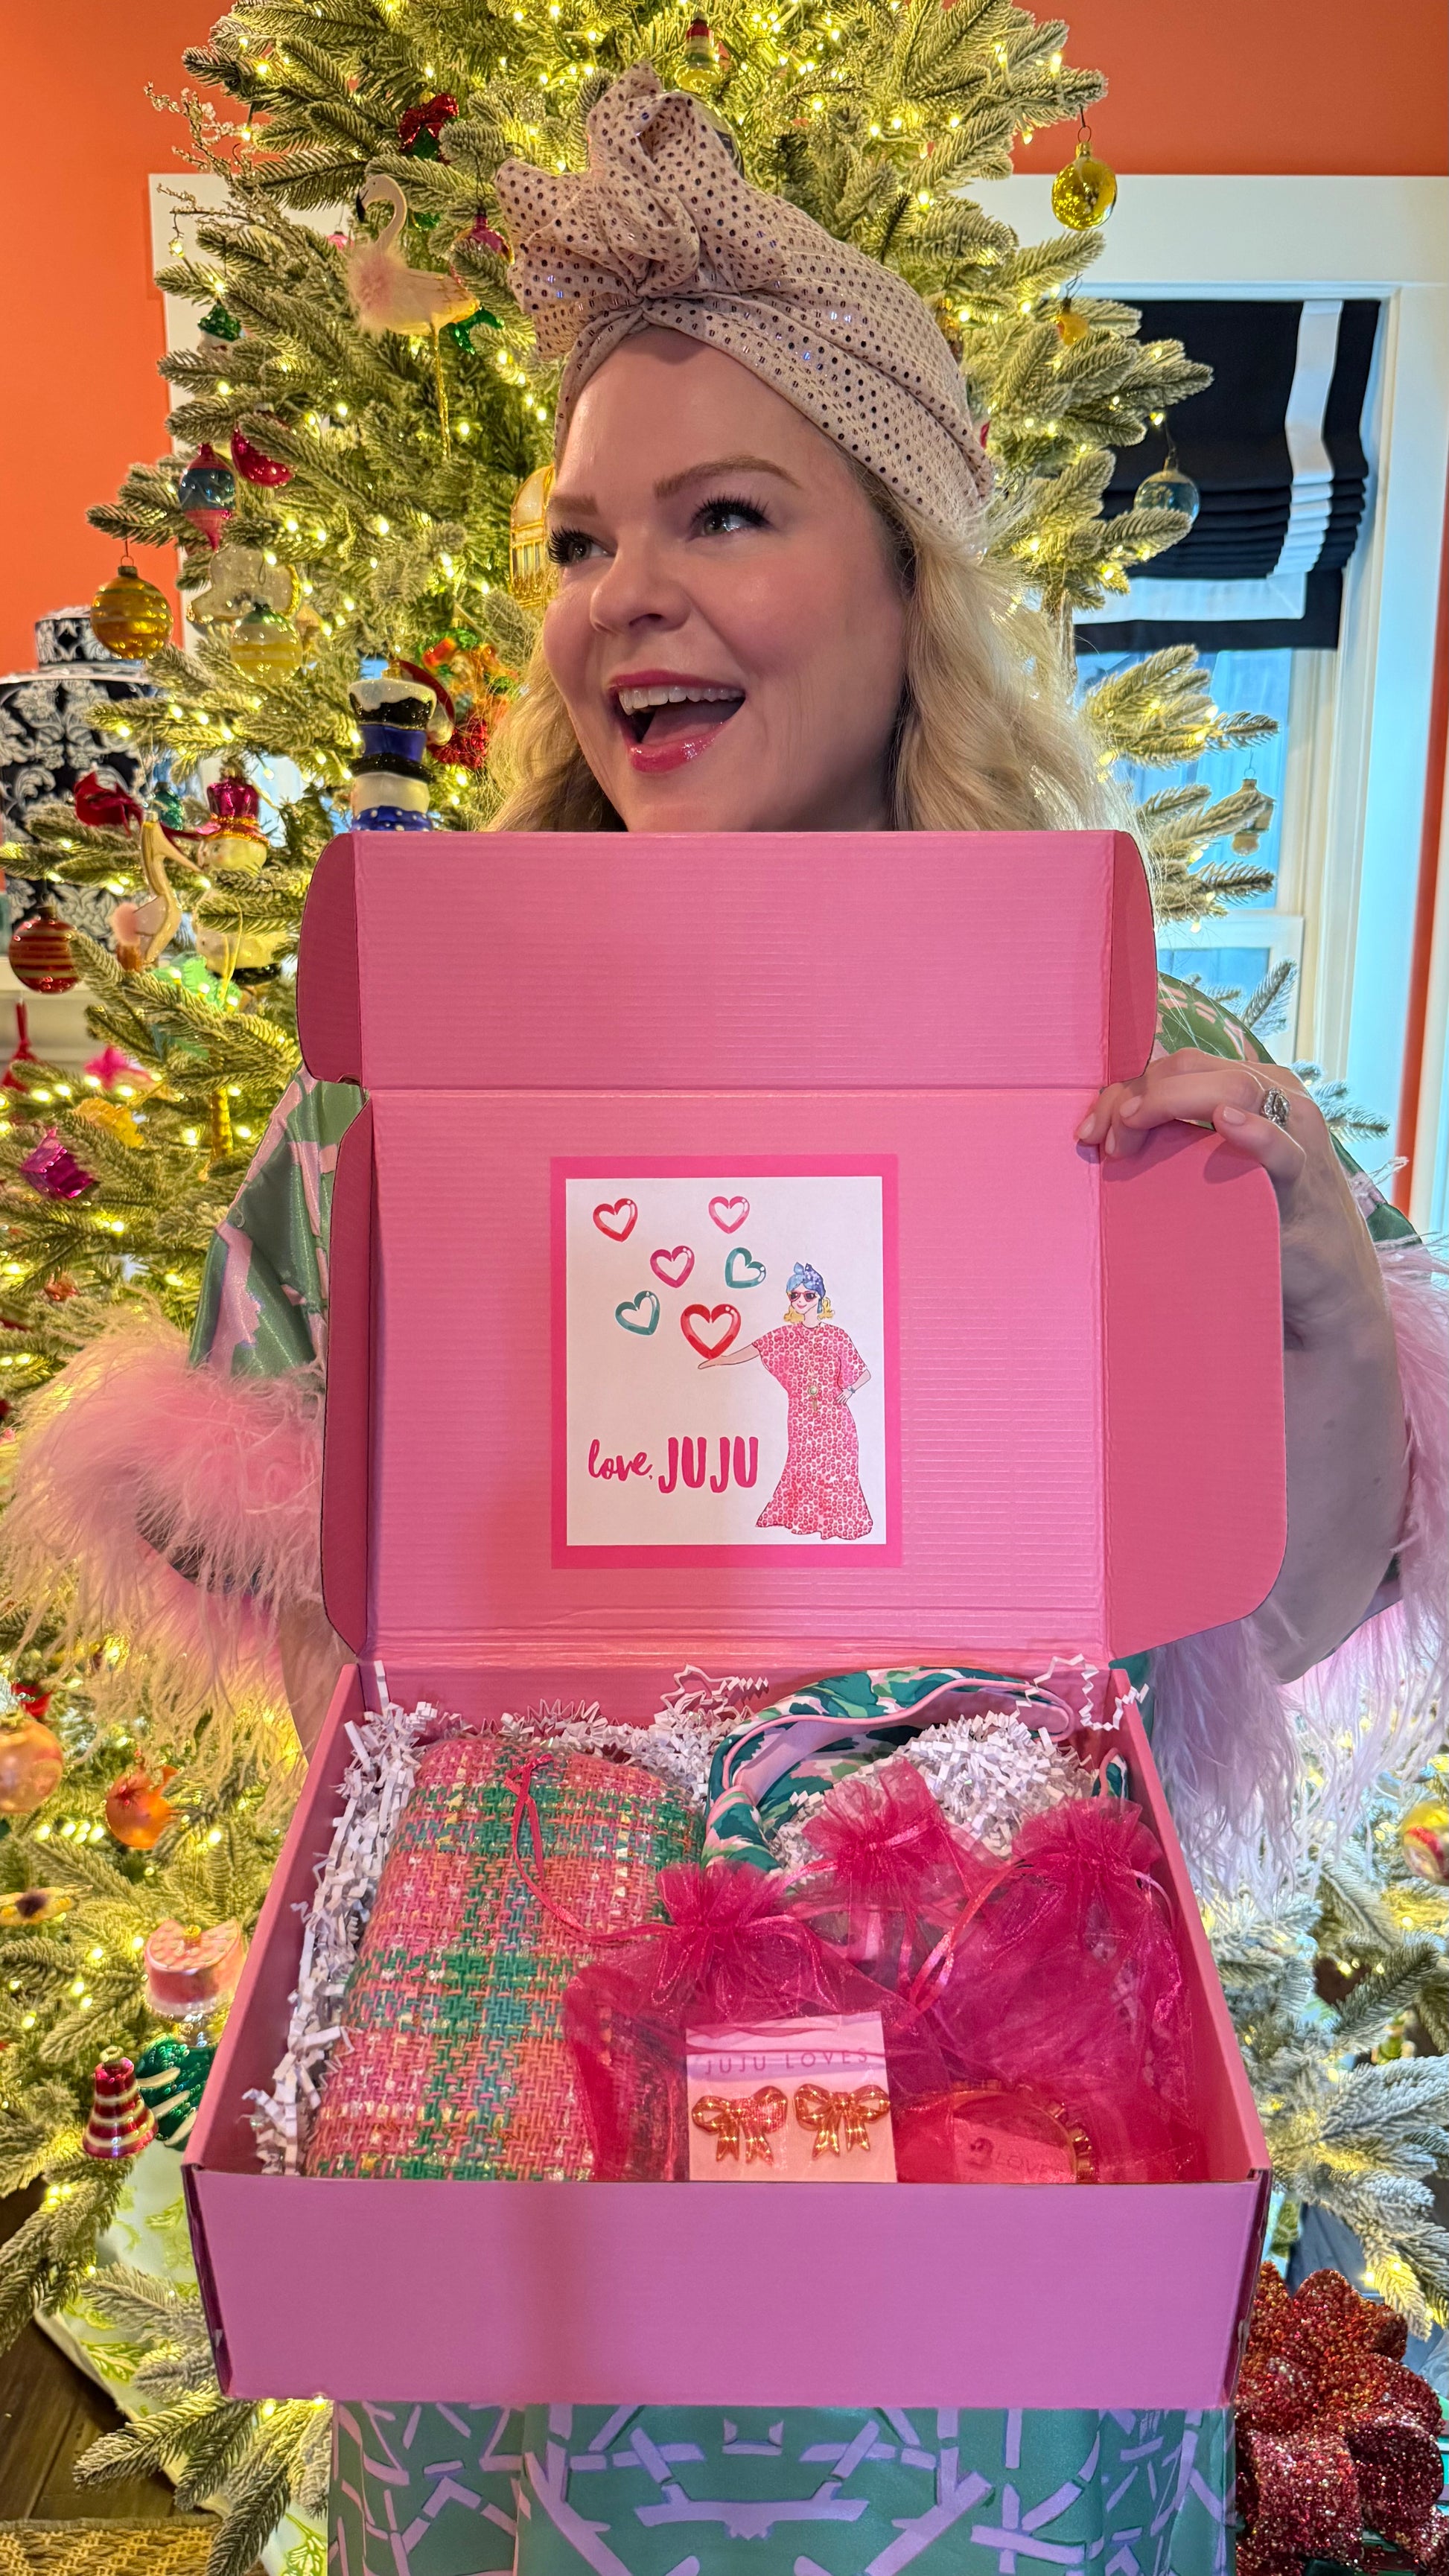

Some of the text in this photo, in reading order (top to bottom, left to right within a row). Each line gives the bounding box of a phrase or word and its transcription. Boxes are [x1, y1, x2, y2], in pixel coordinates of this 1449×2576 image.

[587, 1435, 759, 1493] love, JUJU
[704, 2047, 868, 2076] JUJU LOVES
